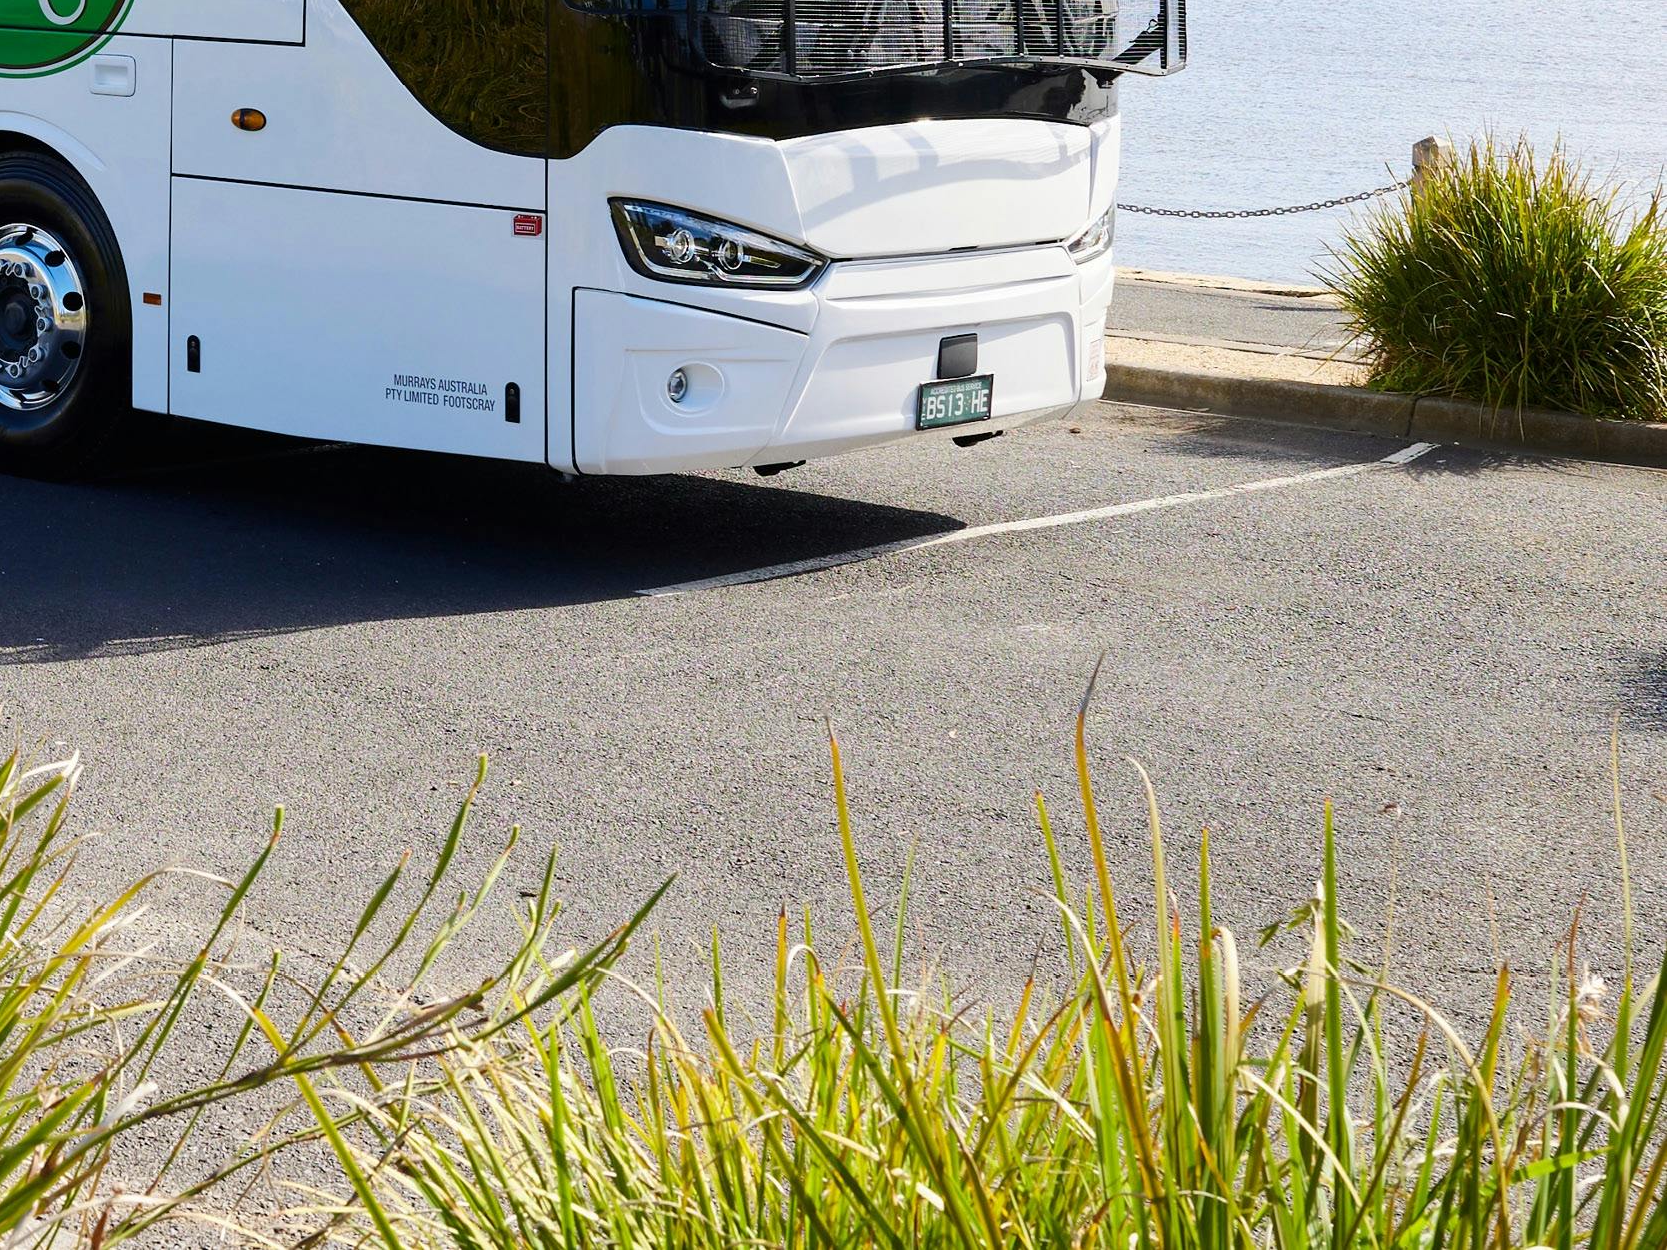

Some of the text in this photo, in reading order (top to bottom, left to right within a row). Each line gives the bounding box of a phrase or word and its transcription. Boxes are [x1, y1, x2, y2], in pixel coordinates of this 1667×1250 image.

[393, 374, 488, 396] MURRAYS AUSTRALIA
[965, 382, 982, 391] SERVICE
[385, 388, 496, 412] PTY LIMITED FOOTSCRAY
[926, 389, 990, 420] BS13 HE
